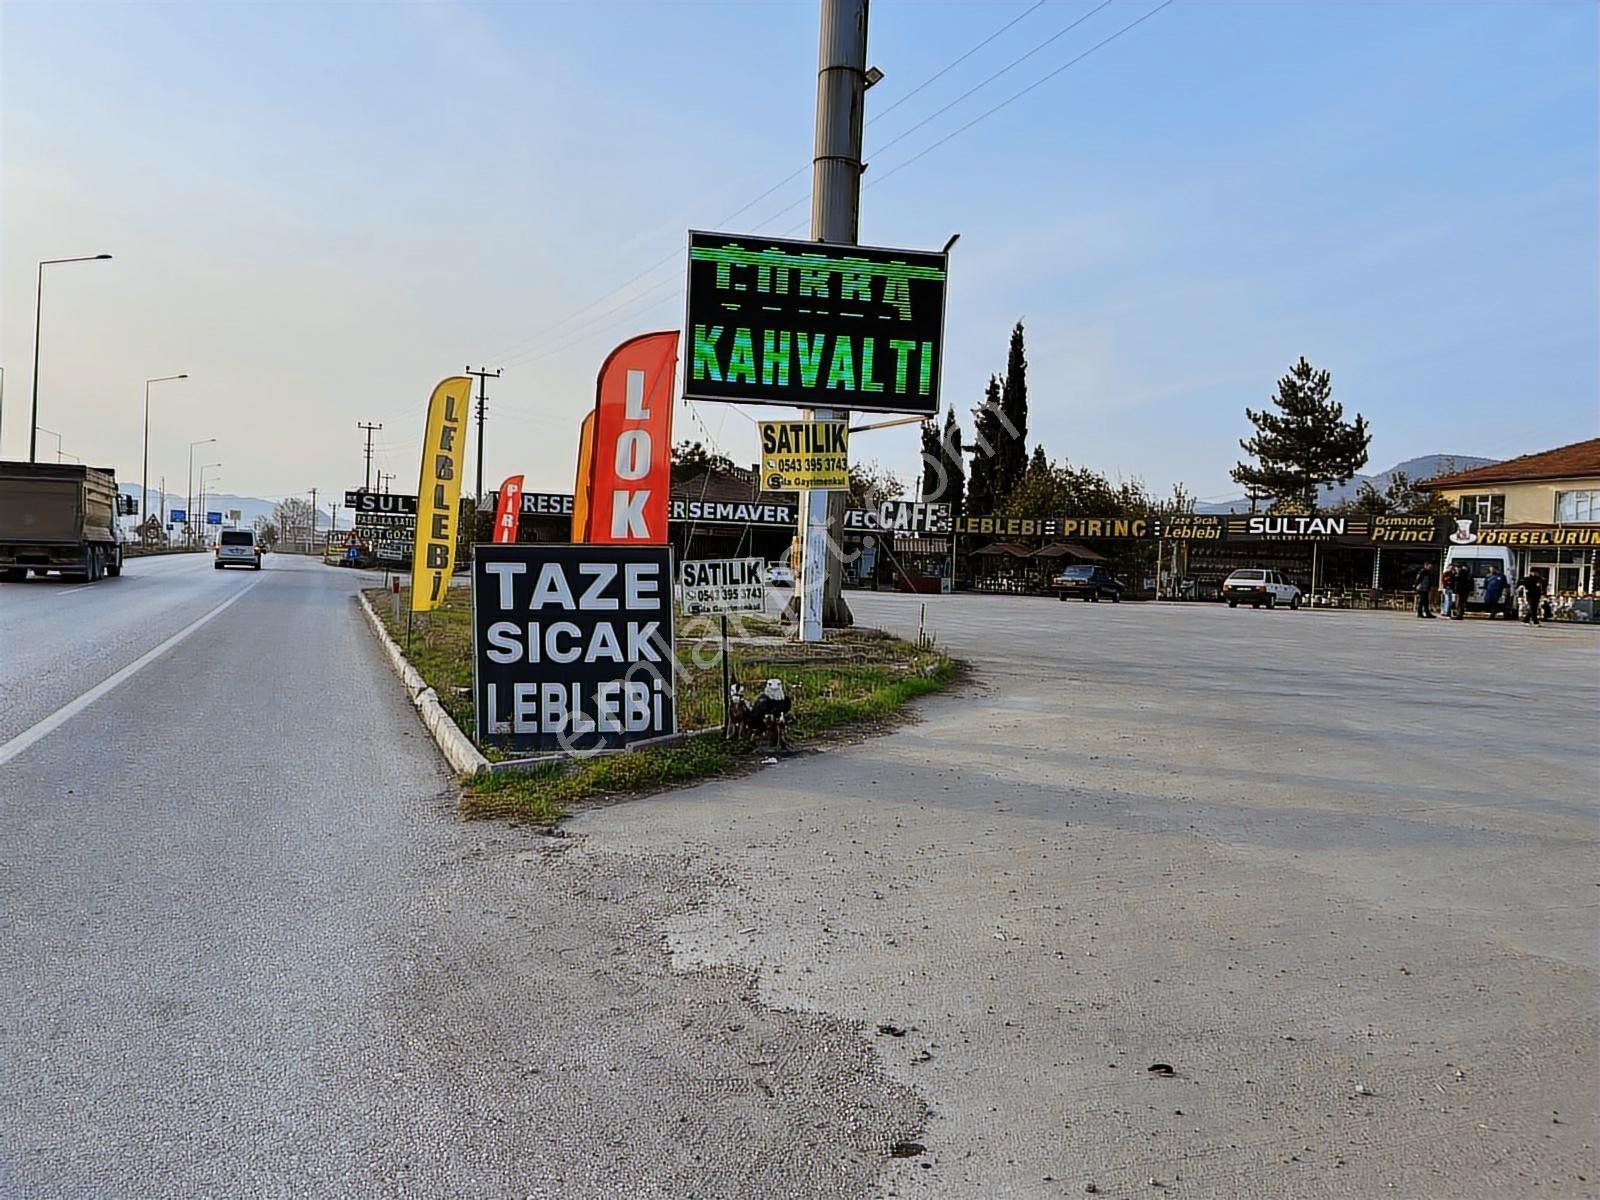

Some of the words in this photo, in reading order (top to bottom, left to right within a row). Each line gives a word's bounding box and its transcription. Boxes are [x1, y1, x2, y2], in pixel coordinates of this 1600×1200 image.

[693, 324, 932, 395] KAHVALTI
[763, 423, 847, 454] SATILIK
[778, 457, 802, 472] 0543
[804, 457, 823, 472] 395
[824, 457, 848, 472] 3743
[689, 501, 790, 522] SEMAVER
[879, 501, 939, 532] CAFE
[1164, 525, 1222, 539] Leblebi
[1249, 517, 1345, 535] SULTAN
[1371, 526, 1436, 541] Pirinci
[683, 561, 762, 587] SATILIK
[485, 562, 661, 611] TAZE
[722, 588, 738, 601] 395
[486, 621, 663, 664] SICAK
